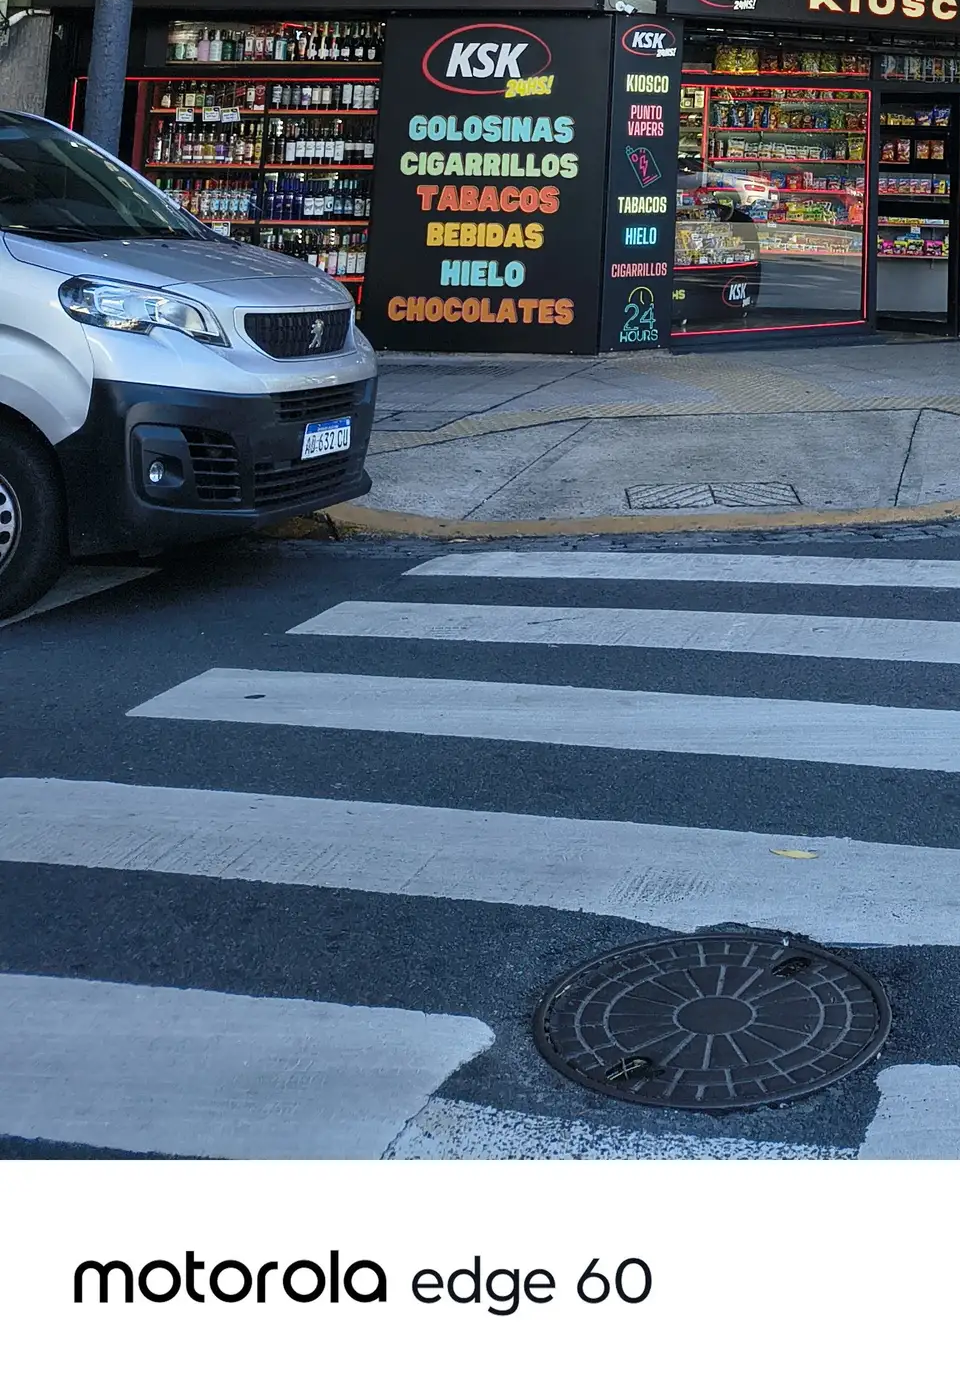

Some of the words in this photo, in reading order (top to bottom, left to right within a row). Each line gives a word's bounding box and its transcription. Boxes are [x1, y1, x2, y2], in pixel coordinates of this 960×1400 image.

[632, 31, 667, 49] KSK
[446, 42, 529, 78] KSK
[505, 74, 555, 98] 24HS!
[626, 74, 669, 93] KIOSCO
[630, 104, 663, 120] PUNTO
[408, 115, 575, 143] GOLOSINAS
[627, 121, 664, 137] VAPERS
[400, 151, 579, 179] CIGARRILLOS
[416, 185, 560, 214] TABACOS
[617, 196, 667, 214] TABACOS
[426, 222, 545, 249] BEBIDAS
[624, 227, 657, 245] HIELO
[440, 260, 525, 288] HIELO
[611, 262, 668, 278] CIGARRILLOS
[728, 283, 747, 301] KSK
[388, 296, 574, 325] CHOCOLATES
[623, 302, 656, 331] 24
[619, 329, 659, 343] HOURS
[319, 432, 335, 451] 632
[337, 429, 349, 448] CU
